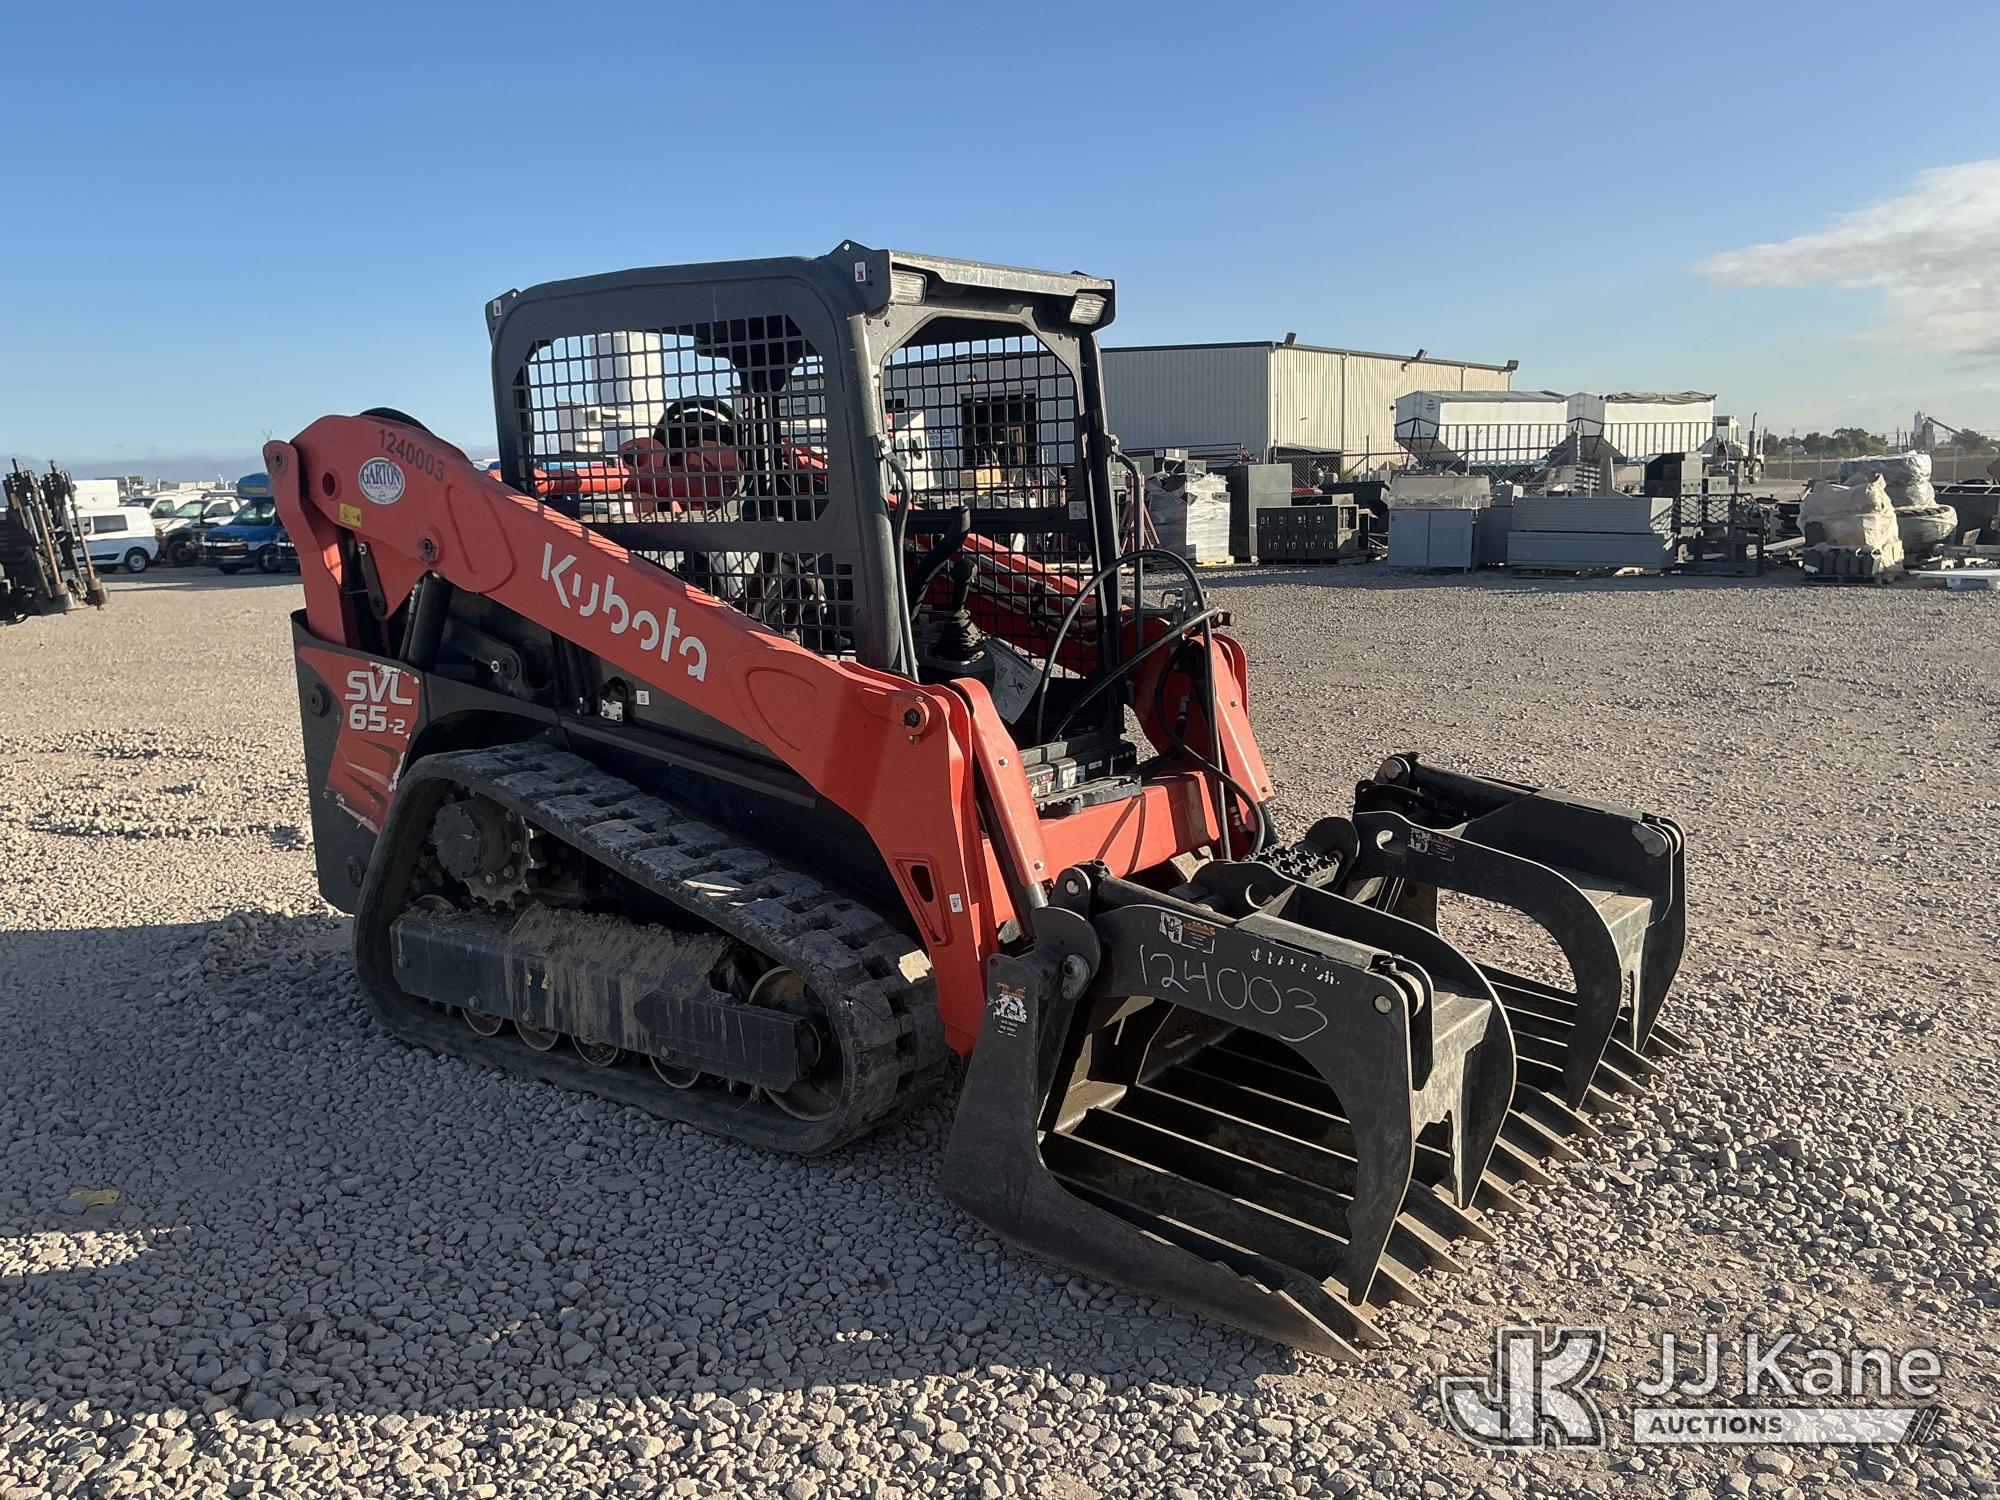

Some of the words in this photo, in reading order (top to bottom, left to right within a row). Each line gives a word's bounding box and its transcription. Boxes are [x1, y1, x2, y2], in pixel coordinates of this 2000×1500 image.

[362, 464, 401, 485] GARTON
[379, 429, 445, 482] 1240003
[541, 542, 709, 681] Kubota
[344, 670, 413, 705] SVL
[349, 703, 406, 735] 65-2
[1139, 944, 1328, 1042] 124003
